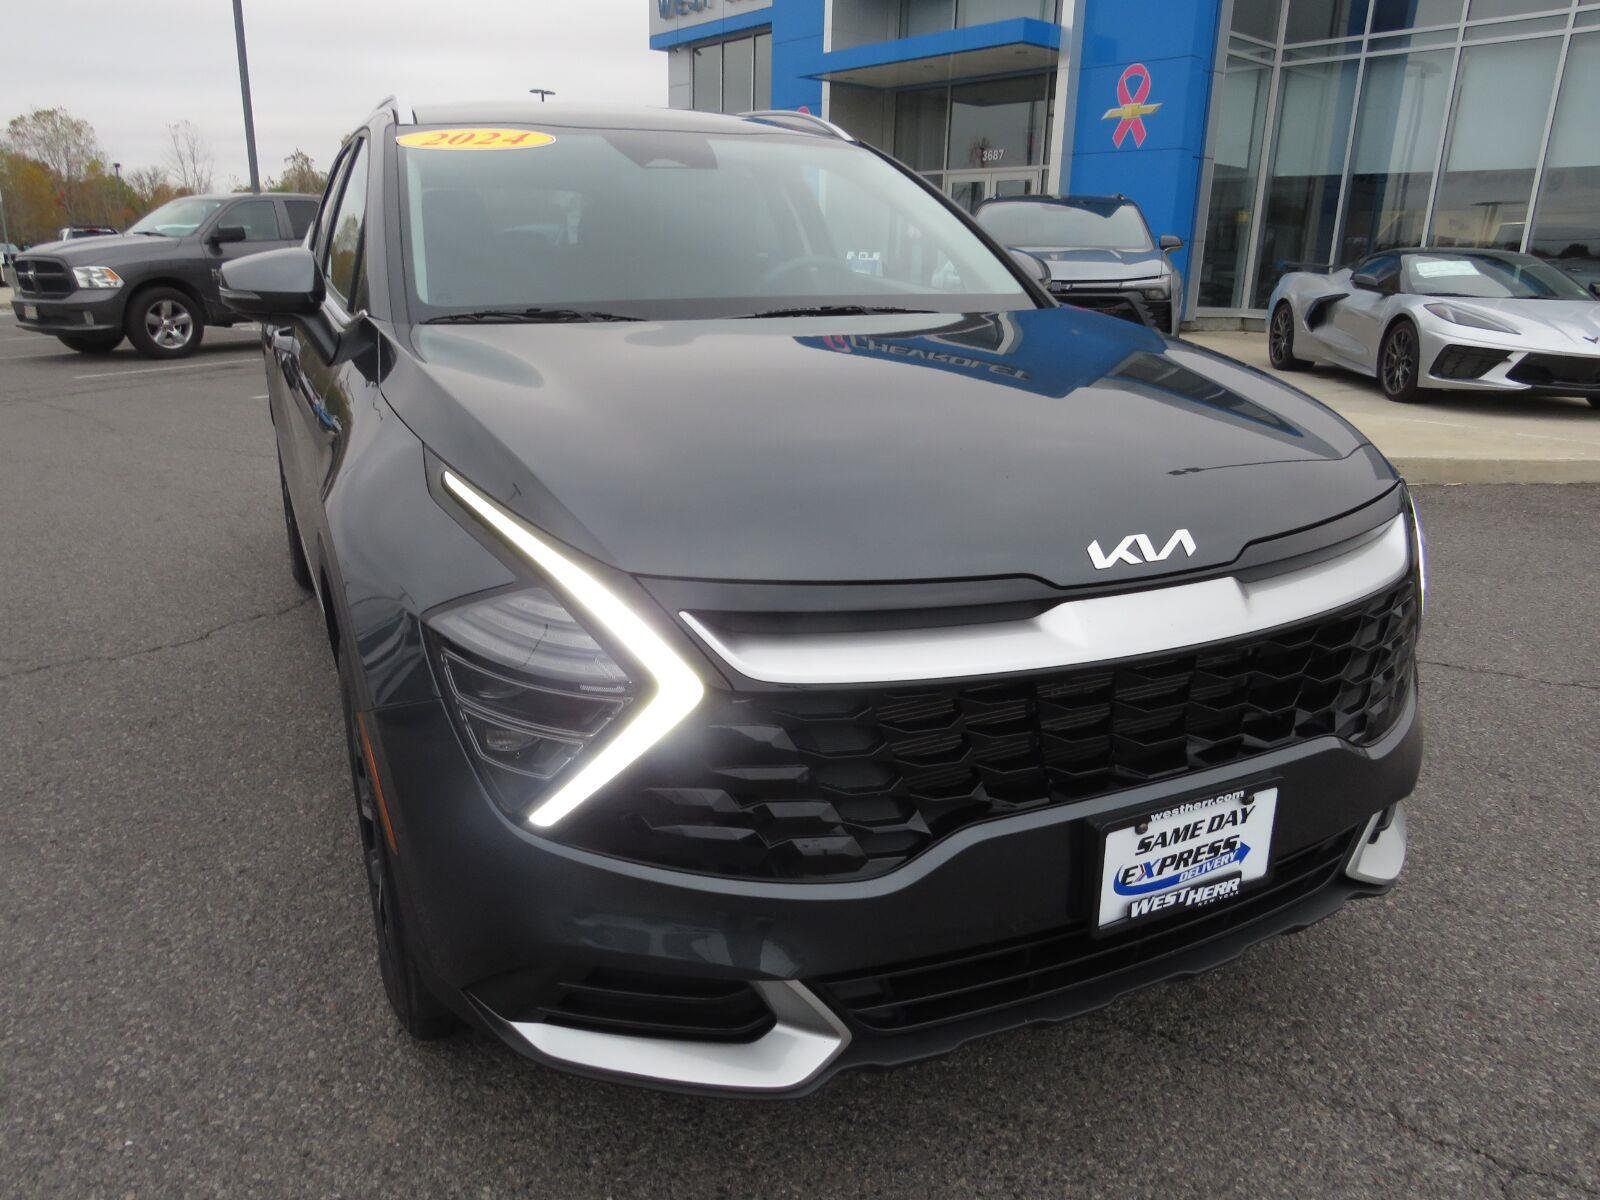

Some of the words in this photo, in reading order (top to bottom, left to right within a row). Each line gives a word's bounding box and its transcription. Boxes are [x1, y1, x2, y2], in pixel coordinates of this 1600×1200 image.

[420, 133, 531, 146] 2024
[982, 149, 1005, 161] 3687
[1087, 528, 1197, 570] KIA
[1150, 790, 1246, 822] westherr.com
[1134, 819, 1206, 856] SAME
[1206, 804, 1256, 834] DAY
[1119, 834, 1240, 887] EXPRESS
[1178, 852, 1238, 882] DELIVERY
[1130, 877, 1241, 918] WESTHERR
